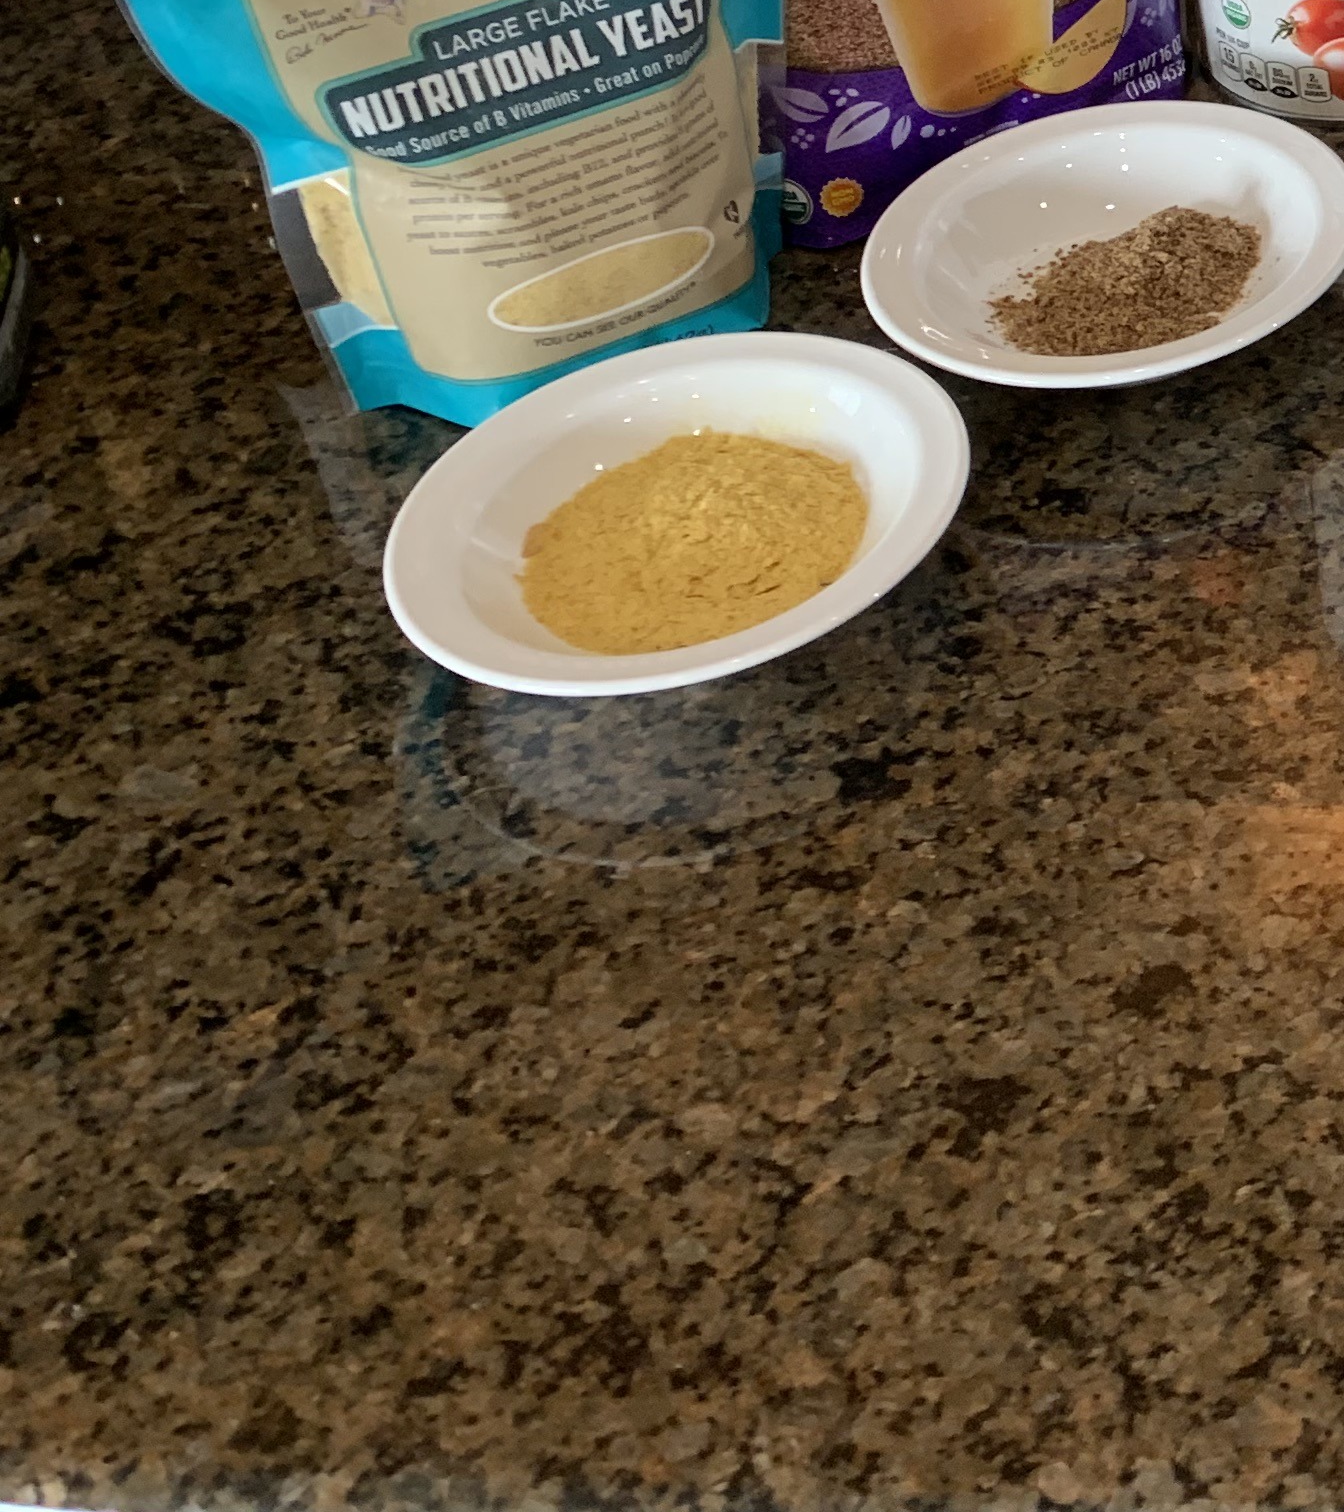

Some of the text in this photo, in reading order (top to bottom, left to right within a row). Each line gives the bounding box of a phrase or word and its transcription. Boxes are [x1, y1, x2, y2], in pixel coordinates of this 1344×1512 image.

[432, 15, 523, 61] LARGE
[339, 28, 601, 138] NUTRITIONAL
[1114, 63, 1135, 86] NET
[1138, 52, 1157, 76] WT
[1159, 45, 1171, 63] 16
[1140, 71, 1161, 94] LB)
[409, 124, 470, 156] Source
[472, 114, 490, 134] of
[492, 110, 507, 128] B
[508, 89, 581, 121] Vitamins
[593, 65, 640, 94] Great
[641, 61, 663, 78] on
[534, 336, 562, 348] YOU
